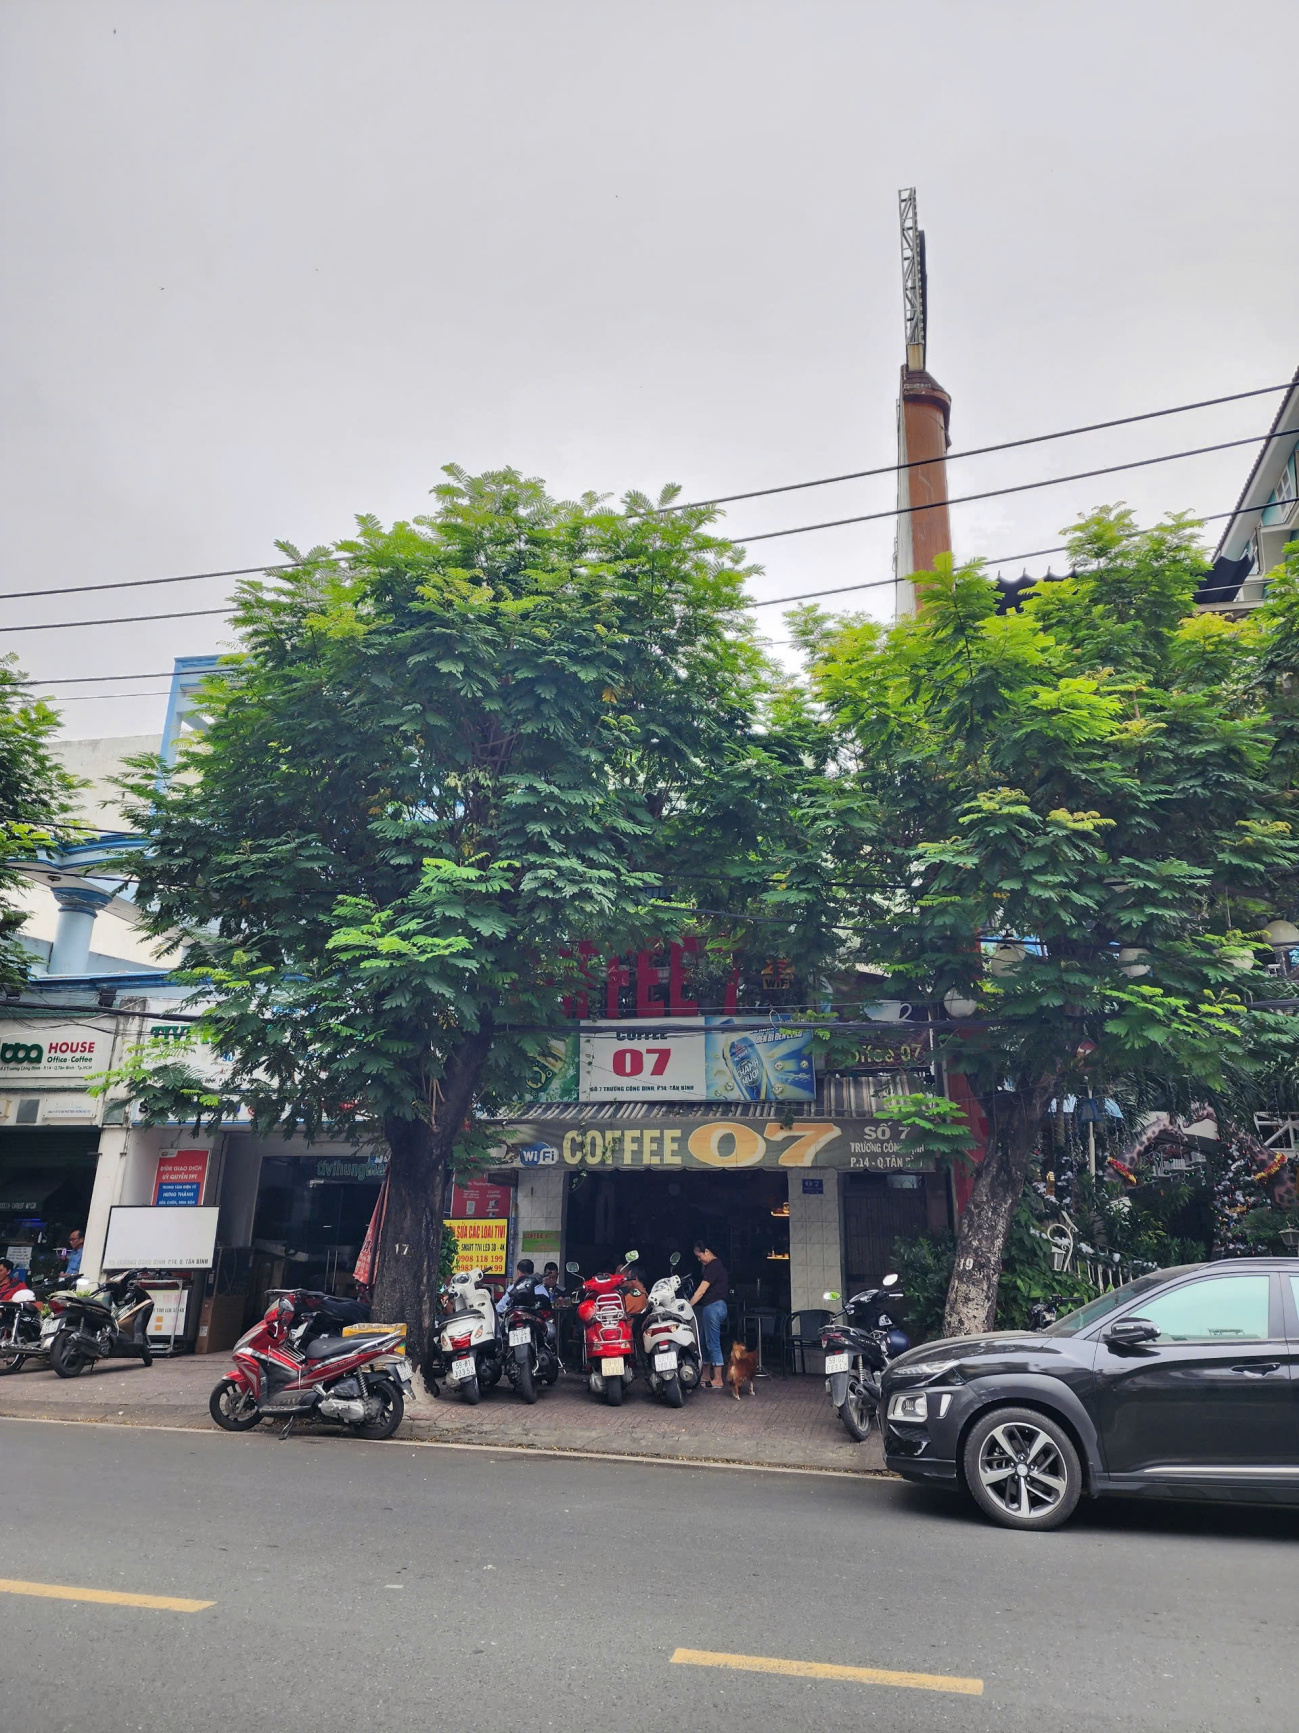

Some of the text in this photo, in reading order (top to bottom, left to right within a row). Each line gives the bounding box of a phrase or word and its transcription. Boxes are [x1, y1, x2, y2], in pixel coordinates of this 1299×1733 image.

[48, 1041, 95, 1054] HOUSE
[70, 1055, 93, 1063] Coffee
[612, 1048, 671, 1077] 07
[864, 1121, 911, 1140] SỐ 7
[562, 1121, 842, 1167] COFFEE 07
[522, 1149, 555, 1162] WiFi
[850, 1157, 870, 1168] P.14
[877, 1155, 903, 1169] Q.TÂN
[468, 1222, 480, 1239] CÁC
[494, 1225, 506, 1239] TIVI
[394, 1243, 410, 1255] 17
[959, 1258, 974, 1270] 19
